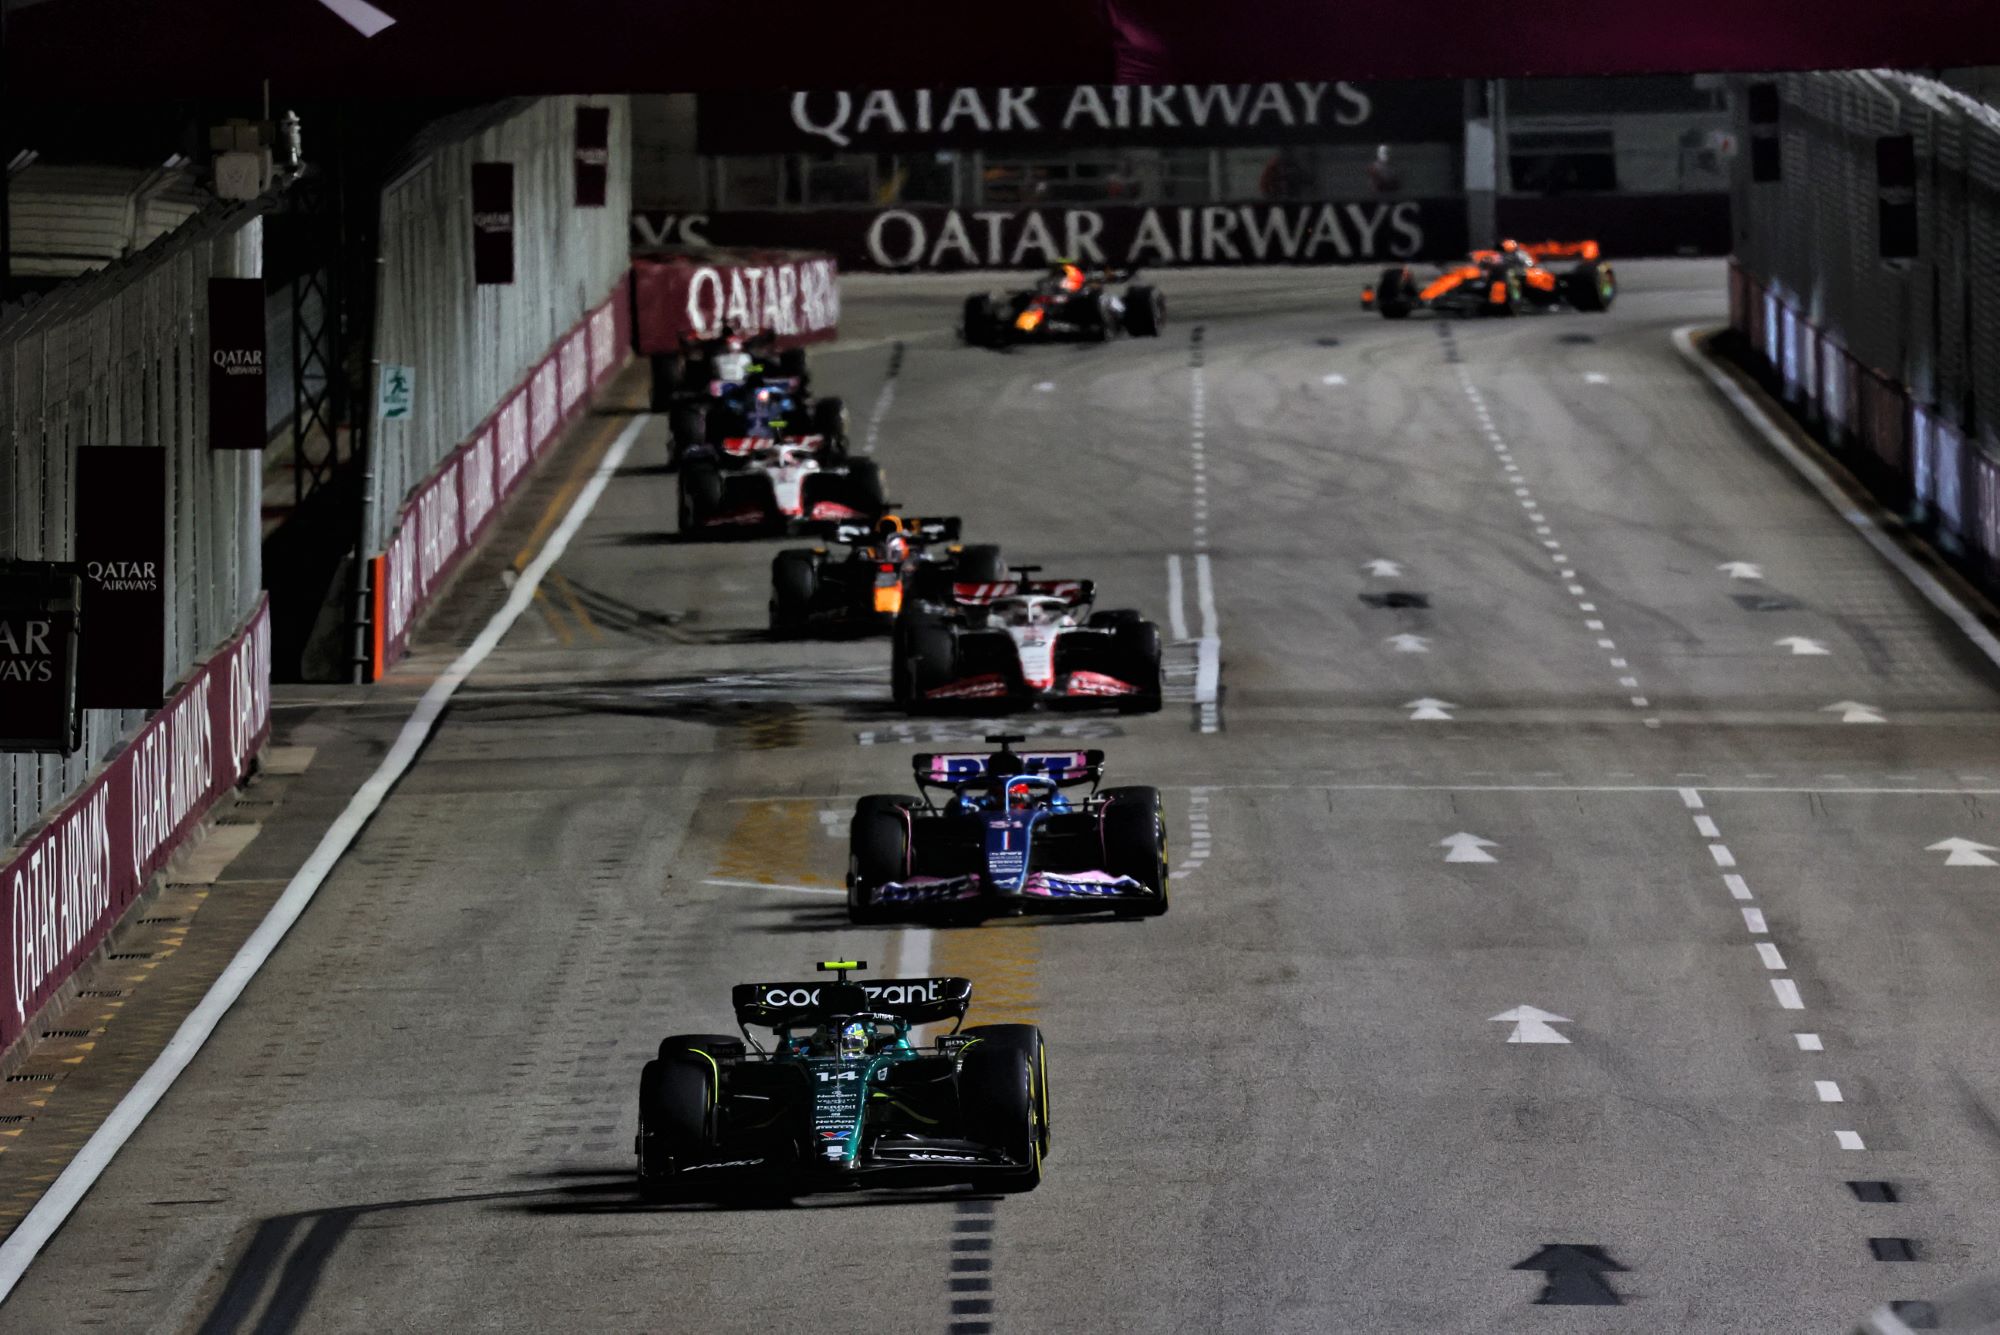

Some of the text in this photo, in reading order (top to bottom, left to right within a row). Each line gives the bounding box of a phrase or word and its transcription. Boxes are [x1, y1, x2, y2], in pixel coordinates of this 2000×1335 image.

[791, 81, 1372, 147] QATAR AIRWAYS
[1127, 201, 1424, 263] AIRWAYS
[213, 350, 262, 368] QATAR
[87, 561, 156, 582] QATAR
[102, 580, 157, 591] AIRWAYS
[132, 720, 170, 886] QATAR
[13, 780, 110, 1025] QATAR AIRWAYS
[816, 1071, 859, 1082] 14
